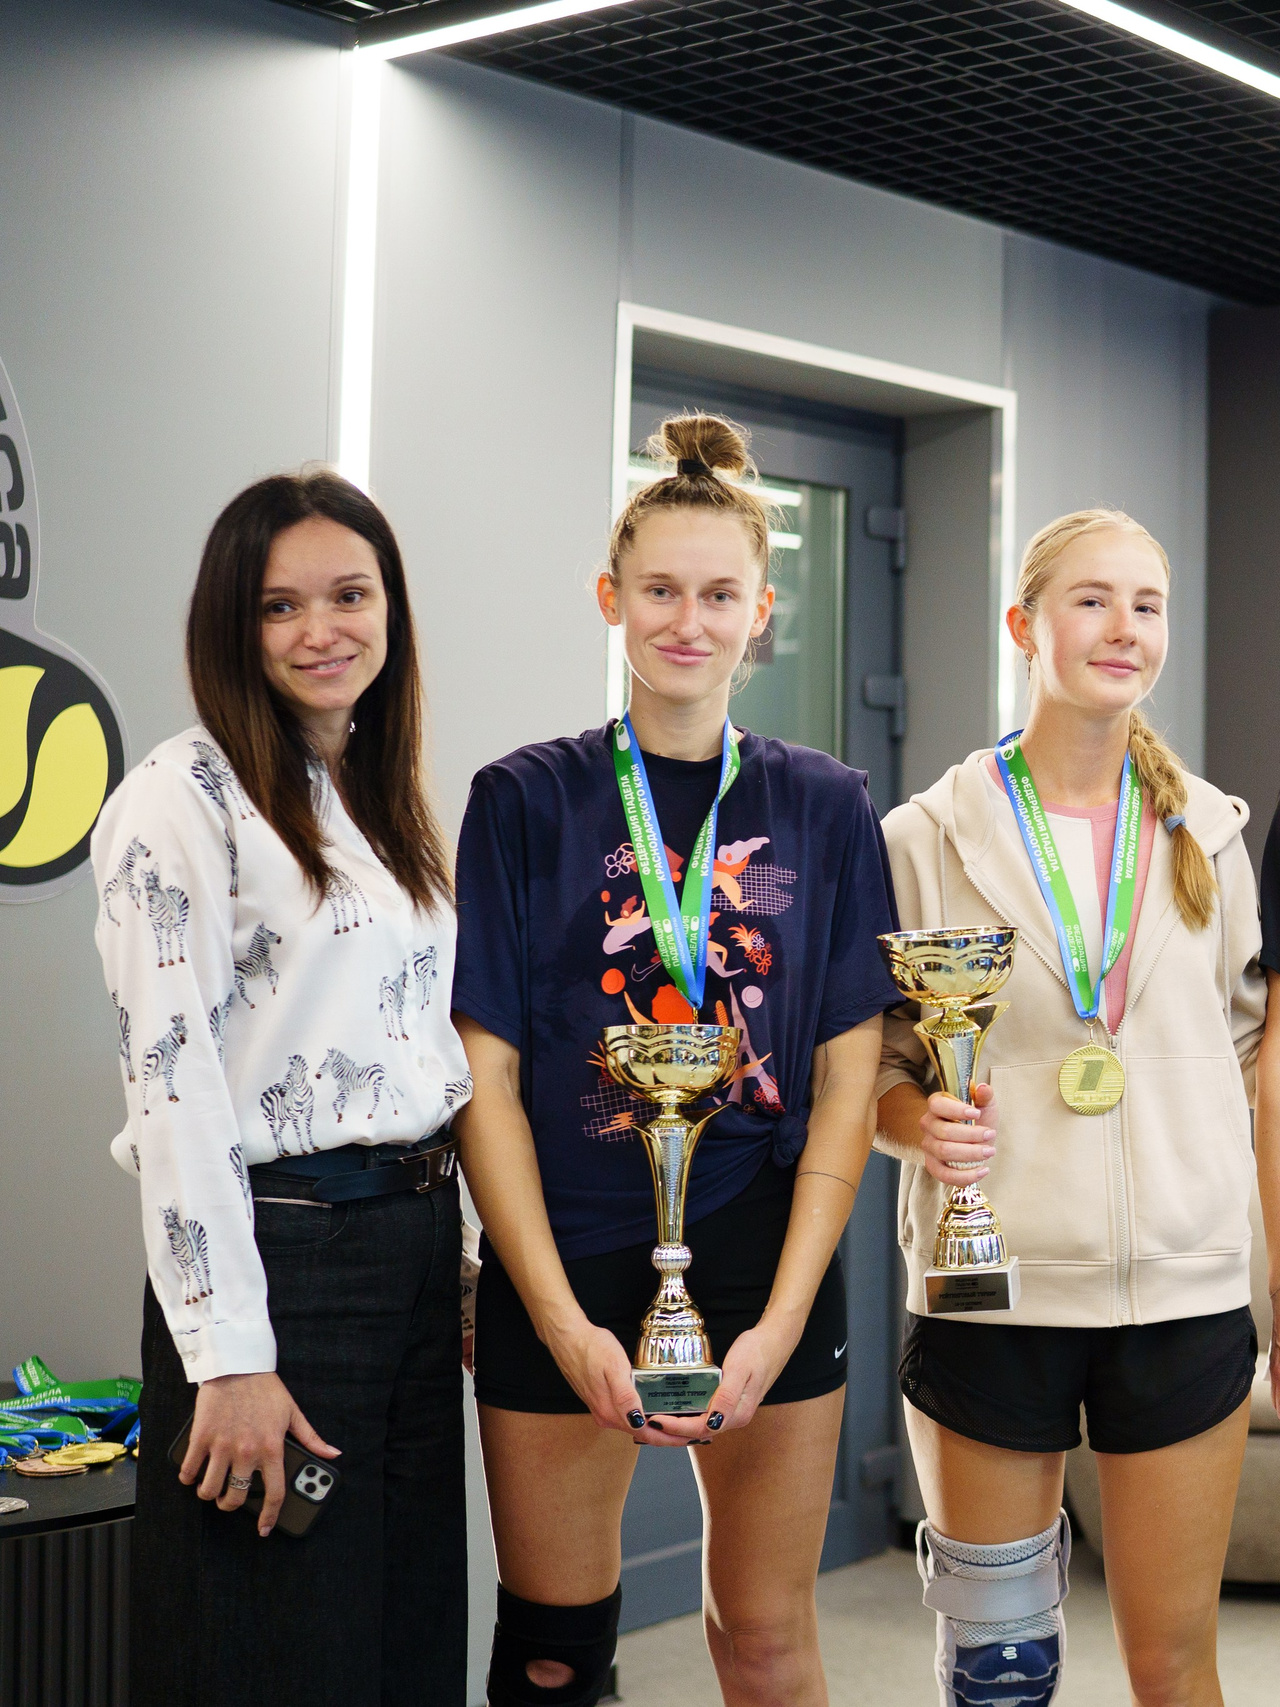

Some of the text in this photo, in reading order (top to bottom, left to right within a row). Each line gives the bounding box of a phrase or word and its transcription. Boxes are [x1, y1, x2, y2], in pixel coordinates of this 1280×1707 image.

[620, 774, 651, 876] ФЕДЕРАЦИЯ ПАДЕЛА
[630, 763, 667, 882] КРАСНОДАРСКОГО КРАЯ
[1006, 773, 1043, 857] КРАСНОДАРСКОГО
[1035, 857, 1052, 883] КРАЯ
[1021, 776, 1060, 872] ФЕДЕРАЦИЯ ПАДЕЛА
[1113, 773, 1132, 884] КРАСНОДАРСКОГО КРАЯ
[1124, 786, 1140, 879] ФЕДЕРАЦИЯ ПАДЕЛА
[653, 920, 671, 969] ФЕДЕРАЦИЯ
[666, 933, 680, 967] ПАДЕЛА
[1065, 925, 1077, 956] ПАДЕЛА
[1073, 924, 1087, 972] ФЕДЕРАЦИЯ
[44, 1395, 71, 1406] КРАЯ
